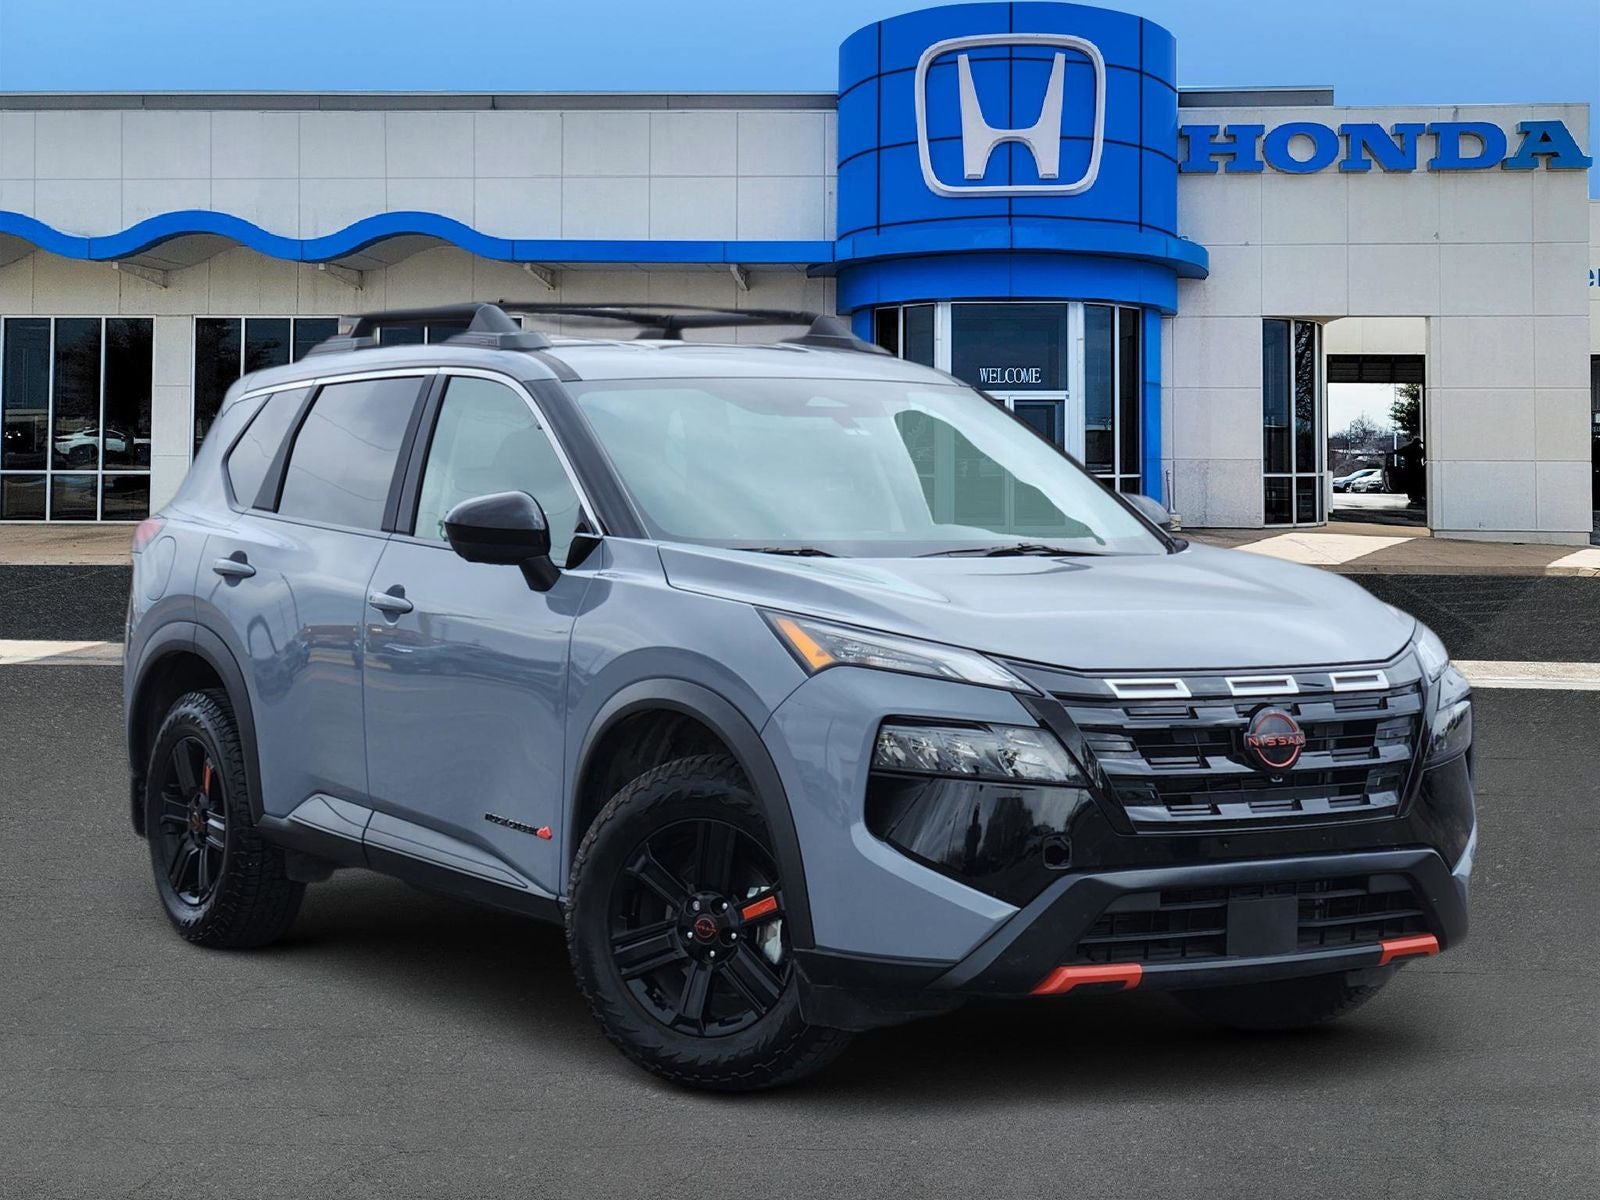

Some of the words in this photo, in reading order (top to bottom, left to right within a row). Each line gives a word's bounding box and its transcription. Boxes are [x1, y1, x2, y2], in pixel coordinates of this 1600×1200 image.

[1178, 120, 1593, 174] HONDA
[979, 367, 1042, 384] WELCOME
[1247, 735, 1305, 747] NISSAN
